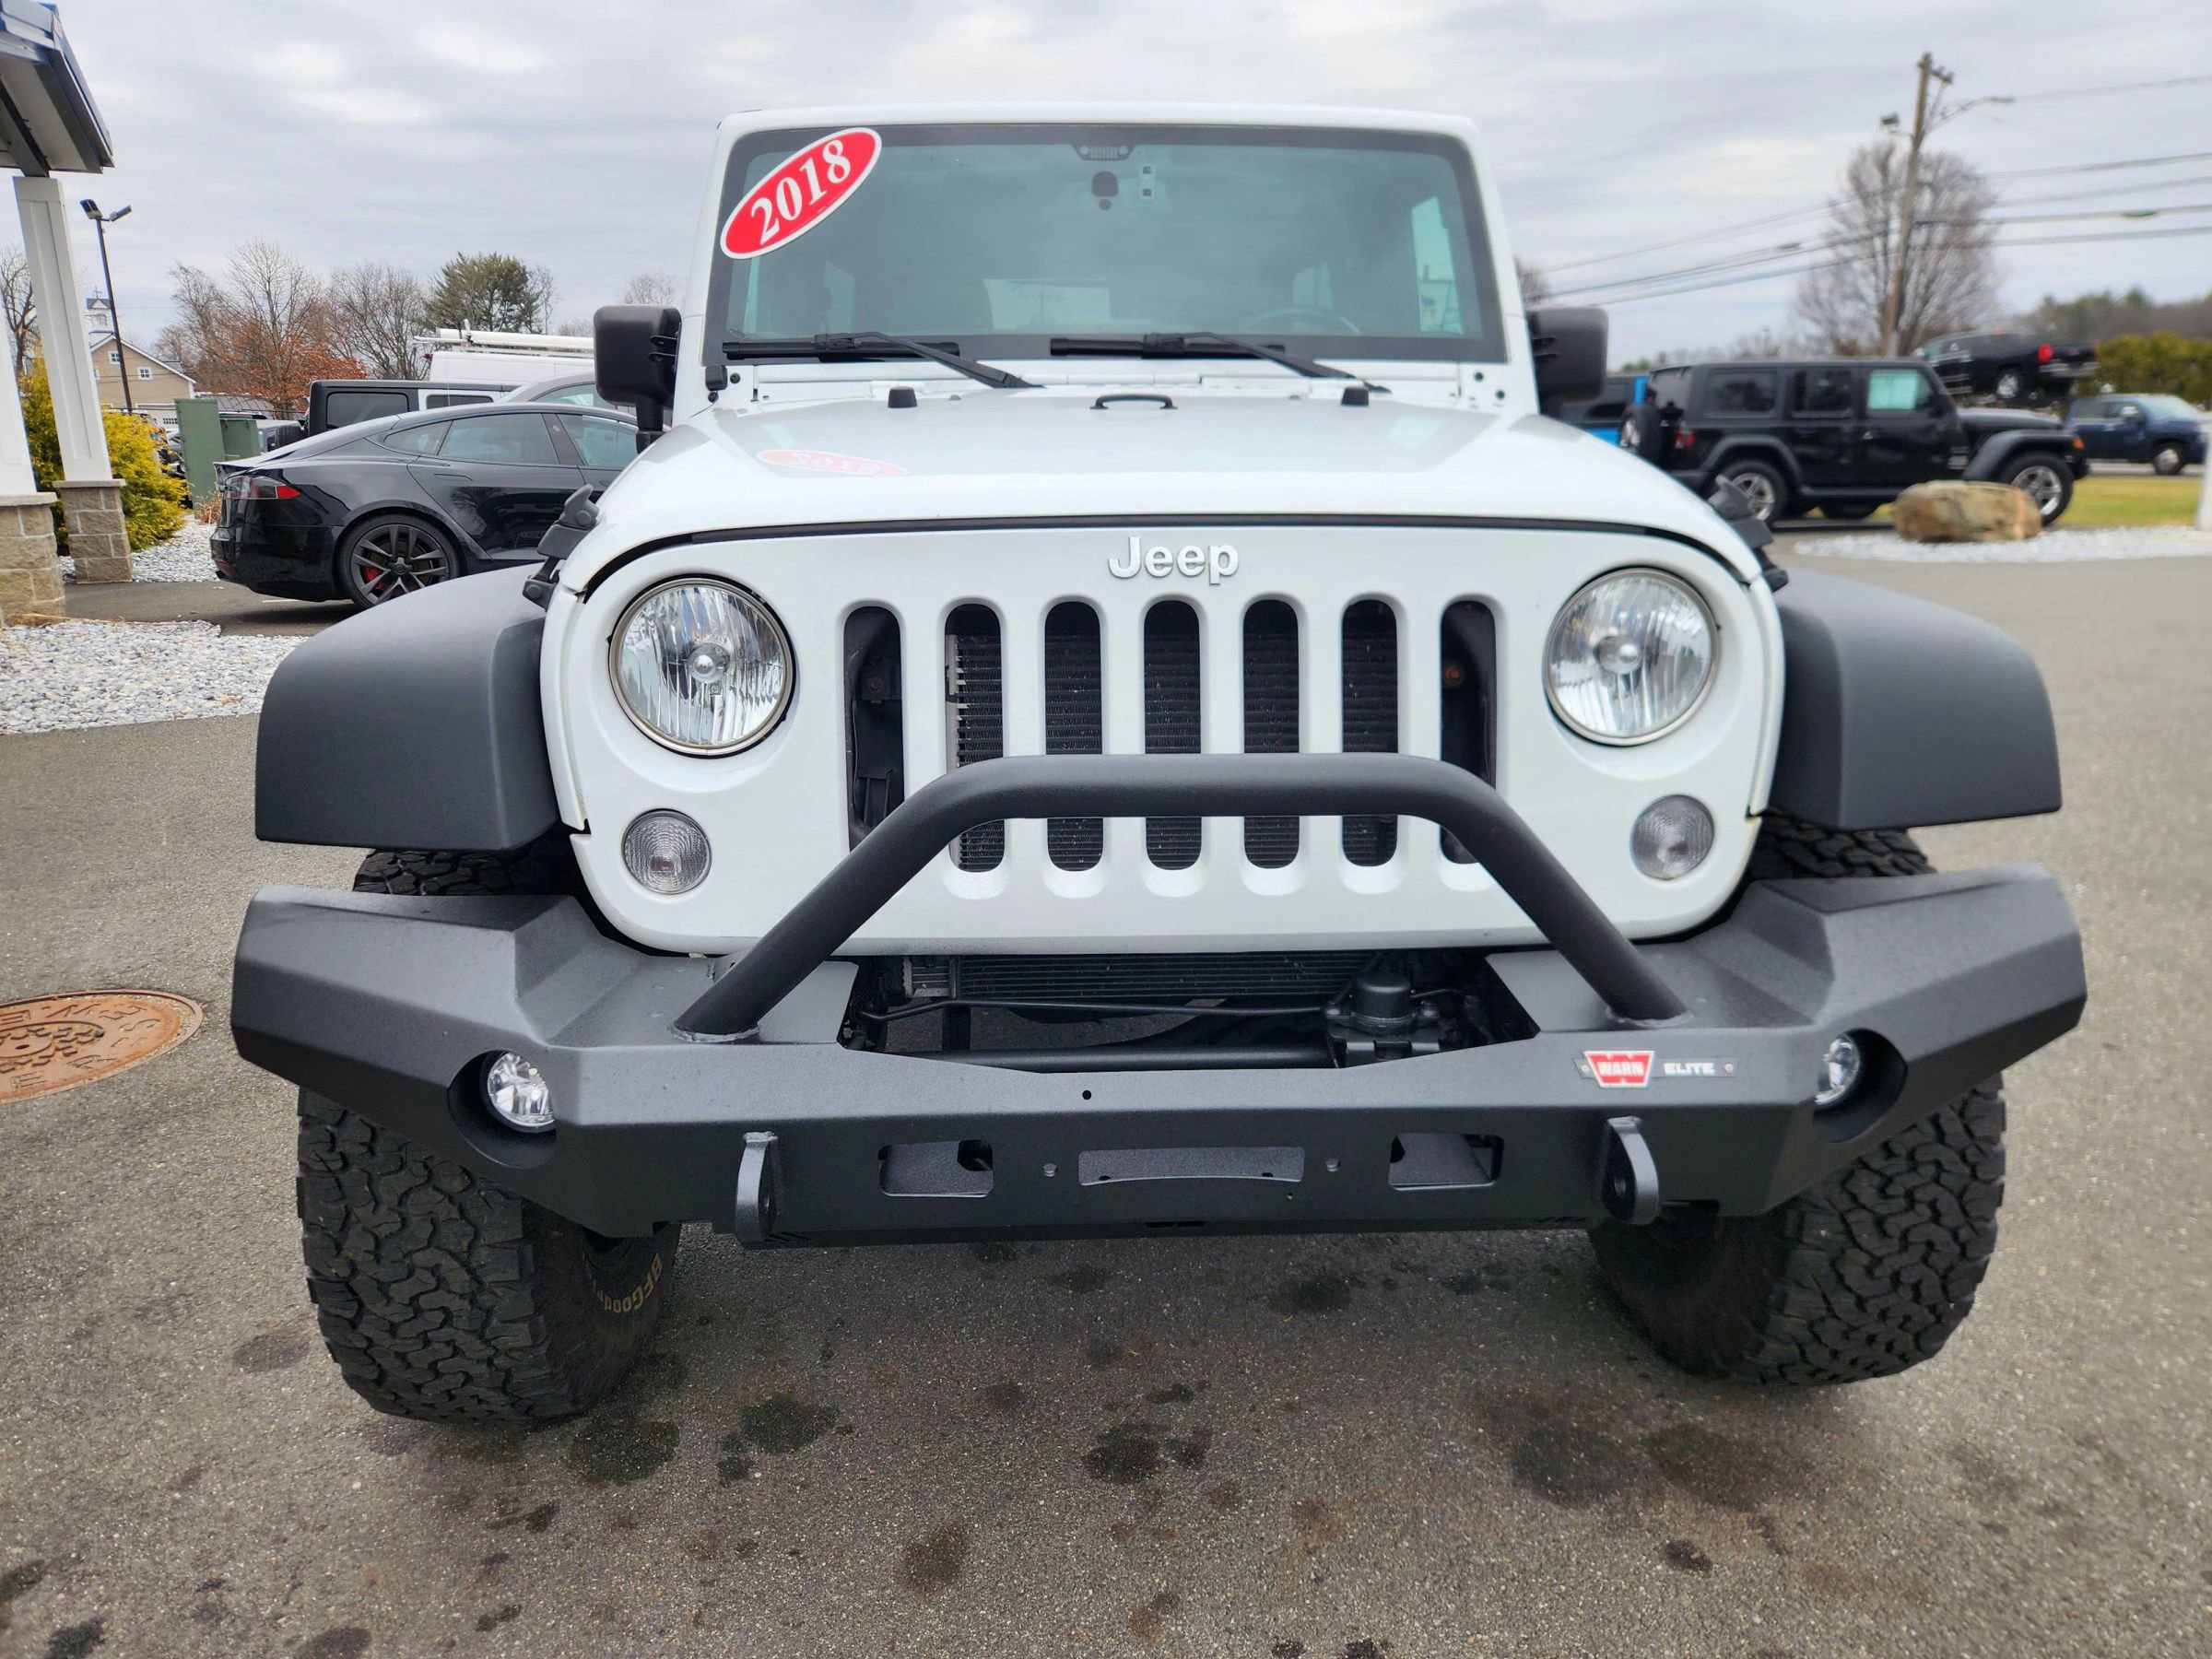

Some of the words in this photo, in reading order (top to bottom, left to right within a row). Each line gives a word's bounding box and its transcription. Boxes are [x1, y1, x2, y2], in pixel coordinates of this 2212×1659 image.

[751, 139, 851, 245] 2018
[1108, 535, 1240, 586] Jeep
[1596, 1061, 1645, 1077] WARN
[1664, 1062, 1716, 1076] ELITE
